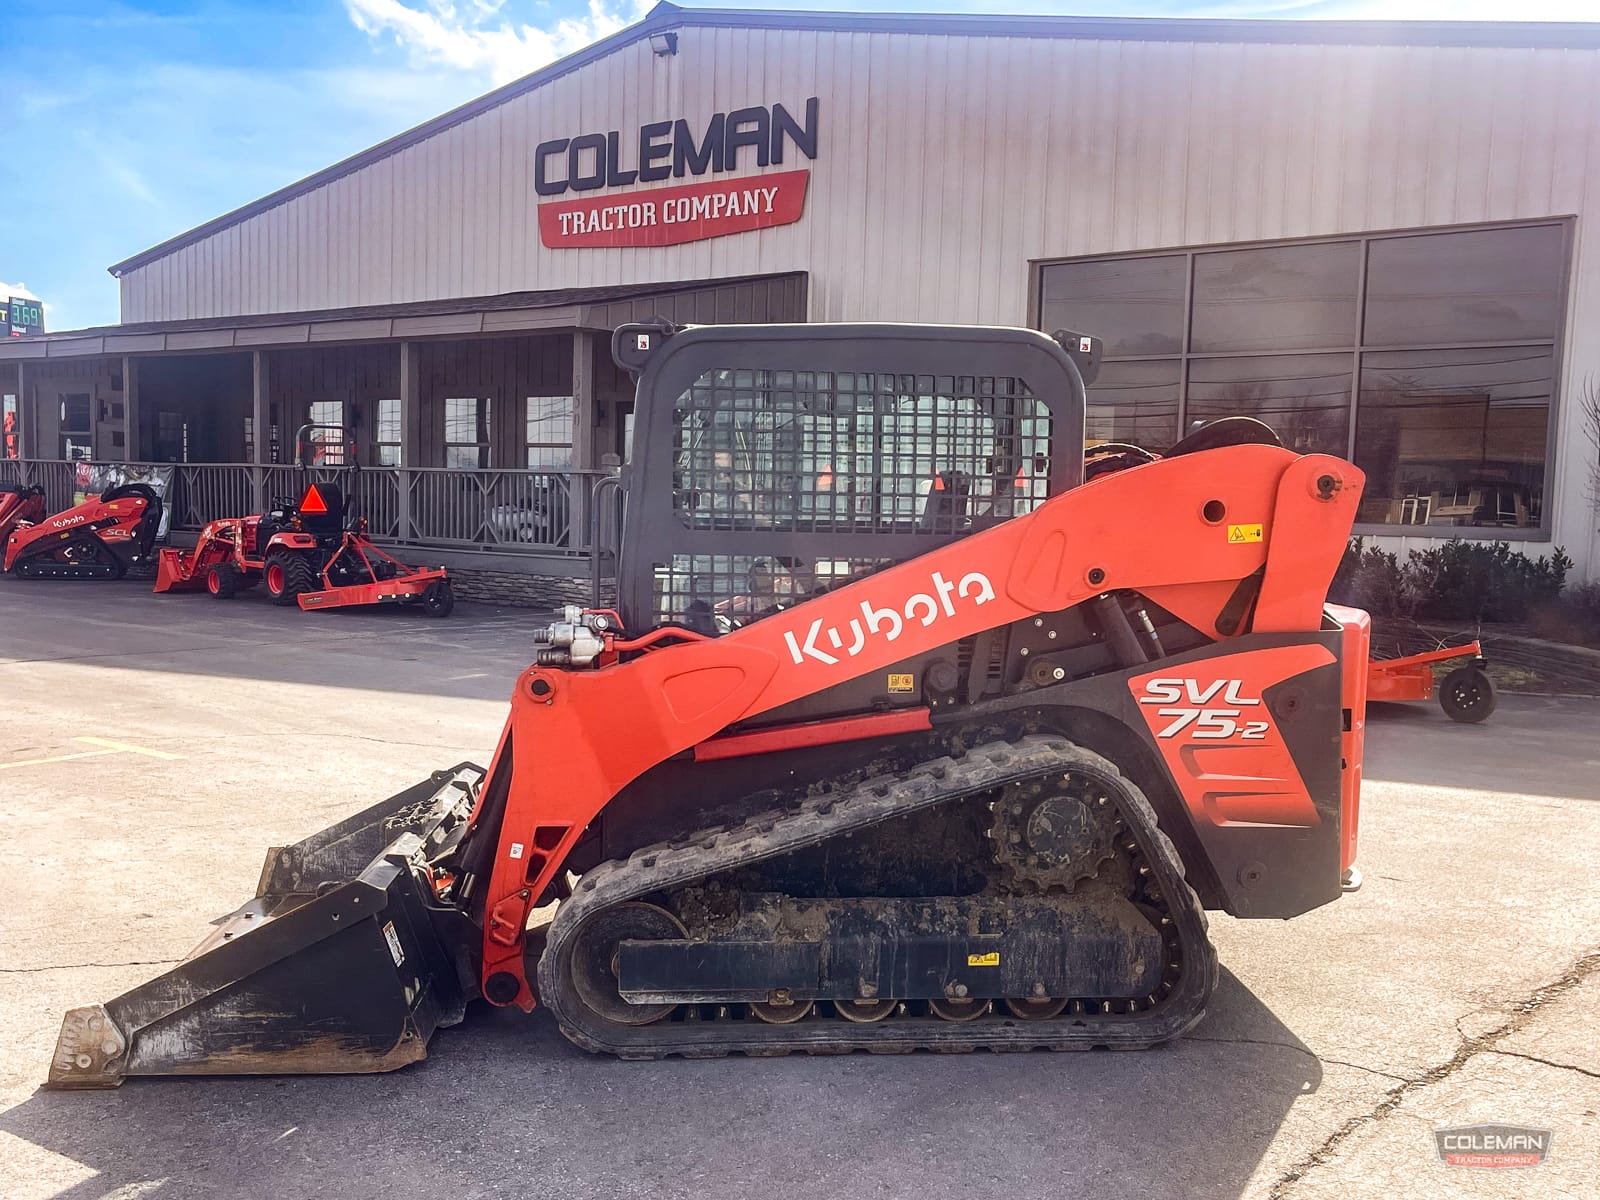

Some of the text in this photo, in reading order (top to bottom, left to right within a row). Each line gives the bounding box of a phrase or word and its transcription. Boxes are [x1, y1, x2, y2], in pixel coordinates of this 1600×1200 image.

[535, 96, 818, 196] COLEMAN
[558, 187, 779, 236] TRACTOR COMPANY
[53, 515, 85, 528] Kubota
[783, 571, 996, 665] Kubota
[1139, 678, 1260, 705] SVL
[1157, 708, 1269, 739] 75-2
